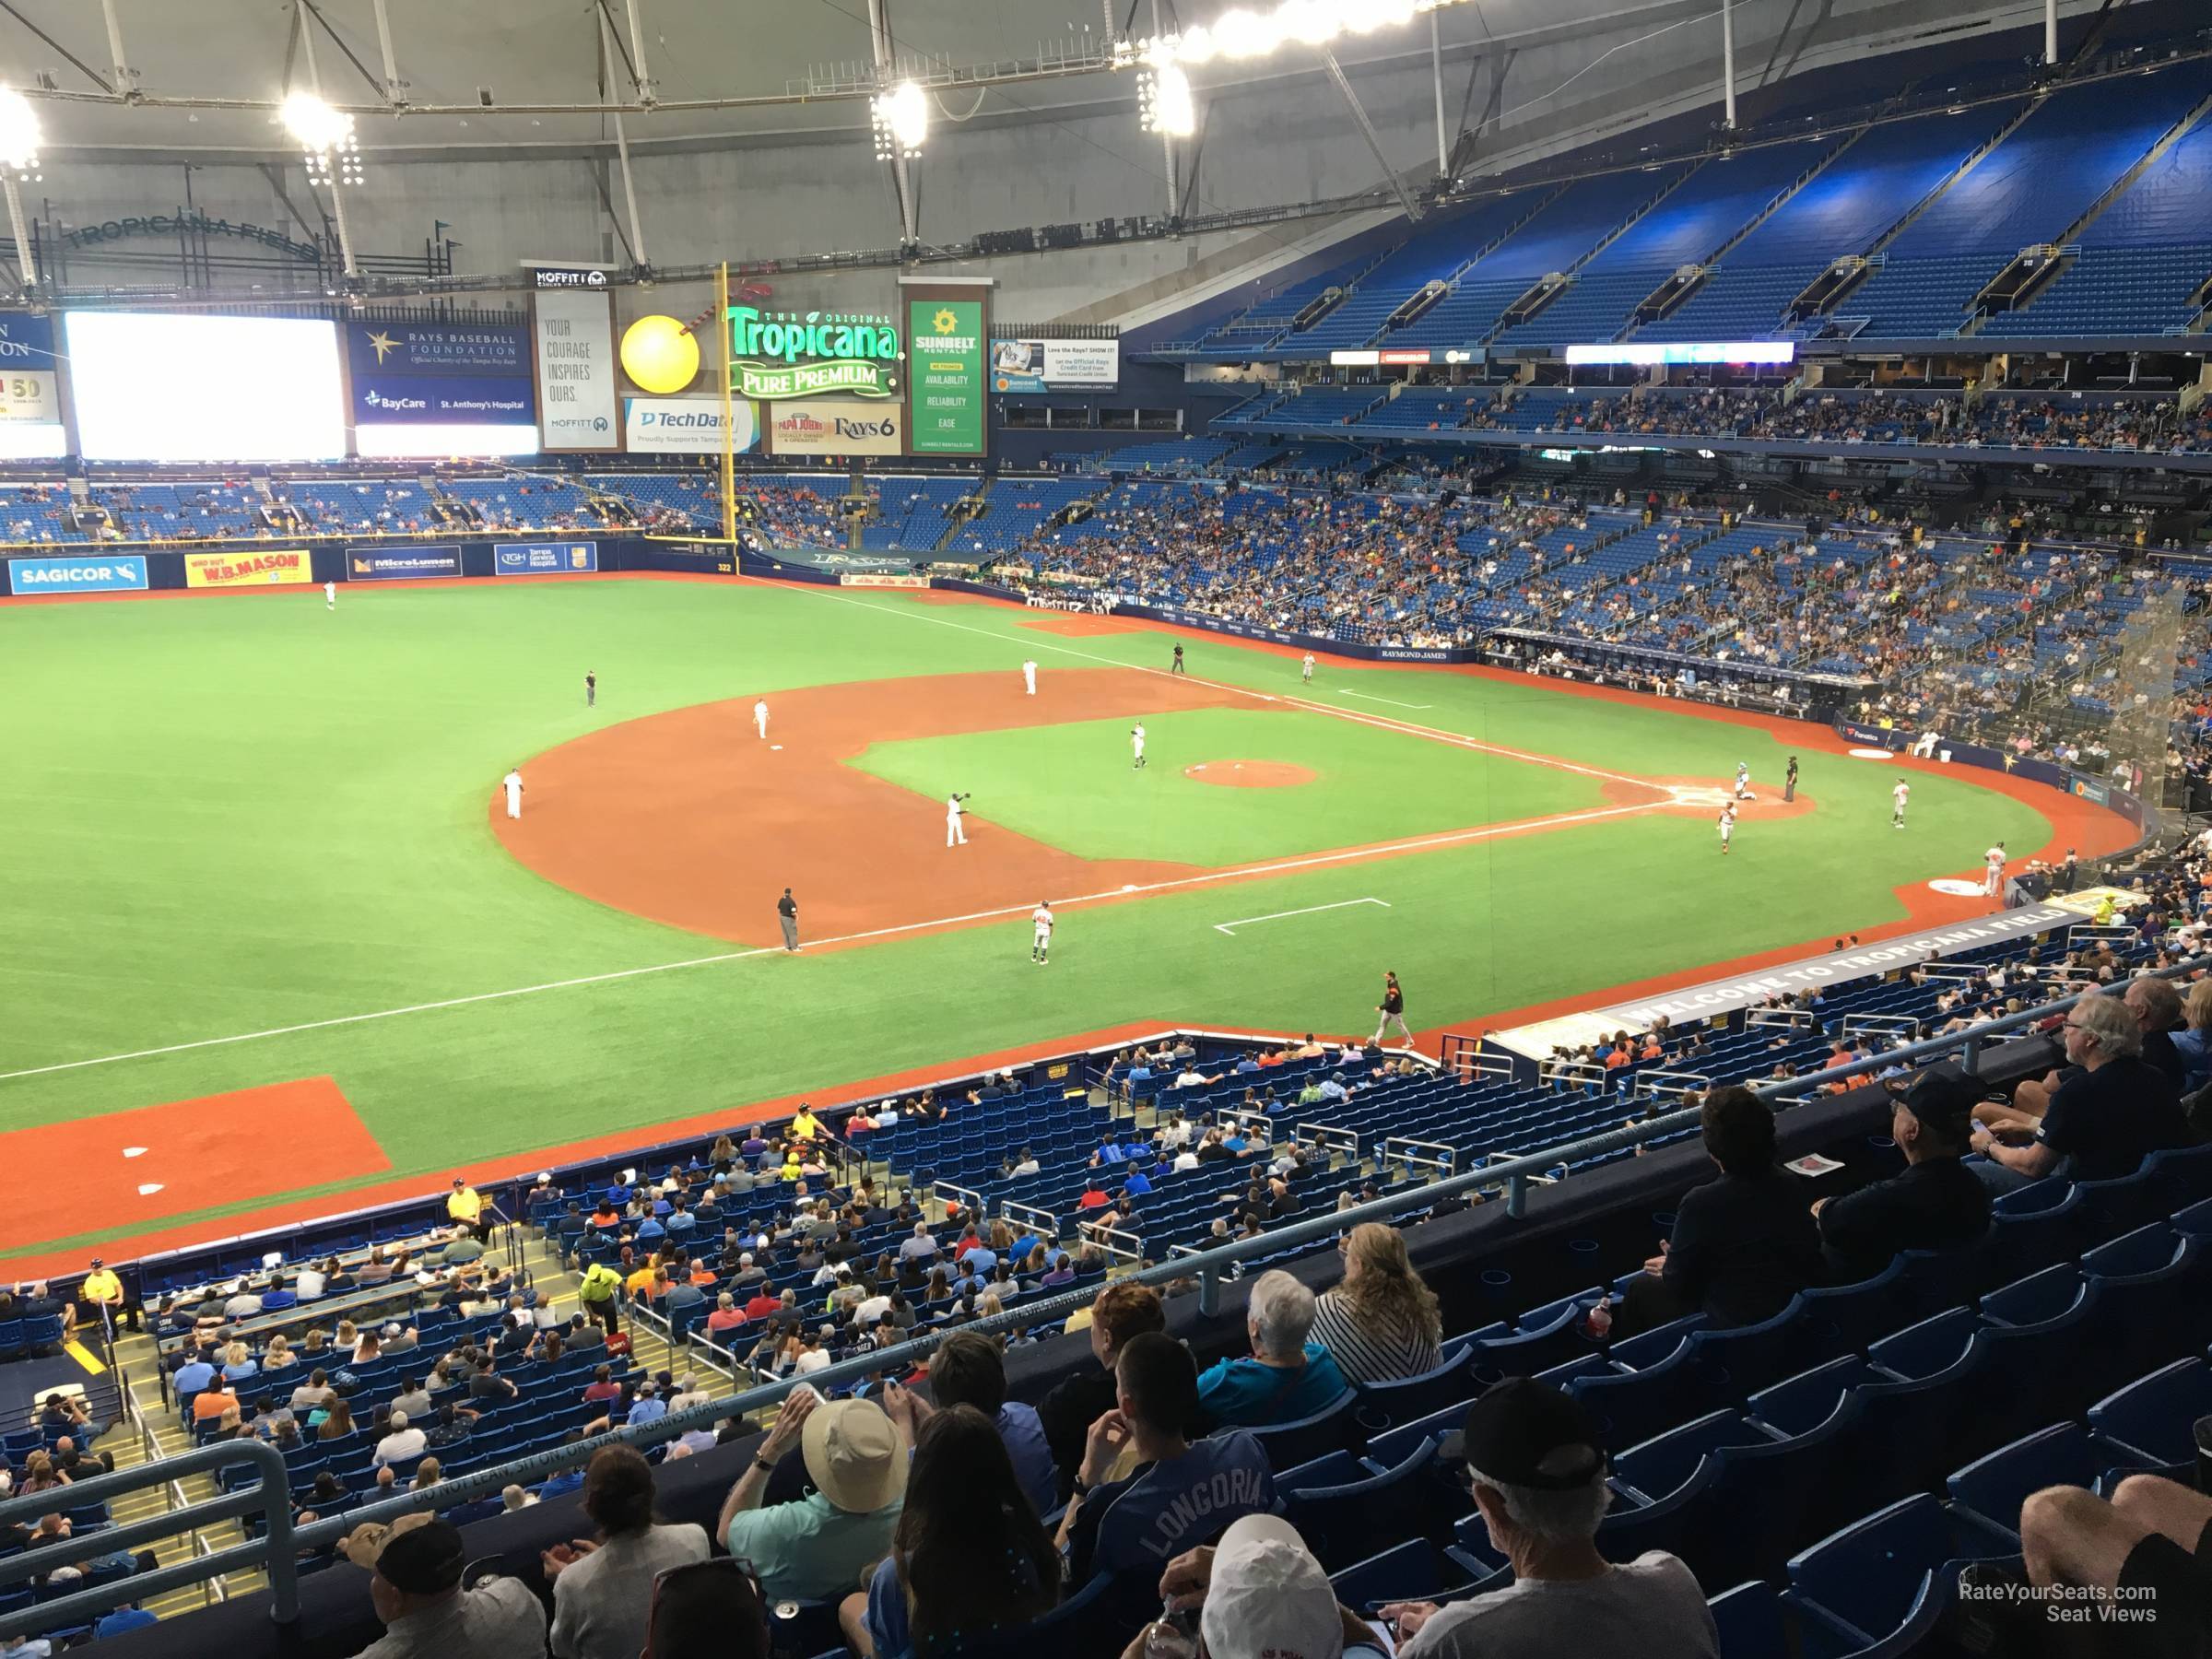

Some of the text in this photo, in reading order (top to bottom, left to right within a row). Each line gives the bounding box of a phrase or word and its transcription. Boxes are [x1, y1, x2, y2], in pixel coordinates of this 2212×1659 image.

[764, 312, 890, 324] THE ORIGINAL
[544, 319, 571, 336] YOUR
[408, 333, 515, 344] RAYS BASEBALL
[722, 306, 898, 362] Tropicana
[915, 336, 976, 348] SUNBELT
[410, 345, 516, 355] FOUNDATION
[546, 342, 591, 359] COURAGE
[547, 364, 591, 380] INSPIRES
[743, 366, 877, 394] PURE PREMIUM
[925, 375, 969, 384] AVAILABILITY
[12, 379, 41, 398] 50
[549, 385, 578, 402] OURS.
[382, 397, 426, 410] BayCare
[453, 400, 491, 410] Anthony's
[492, 400, 524, 410] Hospital
[926, 396, 967, 406] RELIABILITY
[551, 419, 592, 428] MOFFITT
[658, 413, 696, 427] Tech
[779, 418, 797, 430] PAPA
[938, 418, 956, 429] EASE
[879, 418, 895, 437] 6
[374, 558, 455, 567] MicroLumen
[504, 553, 526, 561] TGH
[718, 563, 732, 572] 322
[21, 567, 112, 583] SAGICOR
[1382, 650, 1421, 658] RAYMOND
[1854, 730, 1878, 741] Fanatics
[1620, 909, 2070, 1021] WELCOME TO TROPICANA FIELD
[413, 1488, 436, 1505] DO
[438, 1480, 468, 1497] NOT
[516, 1458, 535, 1474] SIT
[566, 1441, 588, 1456] OR
[635, 1412, 691, 1436] AGAINST
[694, 1401, 724, 1418] RAIL
[1137, 1467, 1264, 1559] LONGORIA
